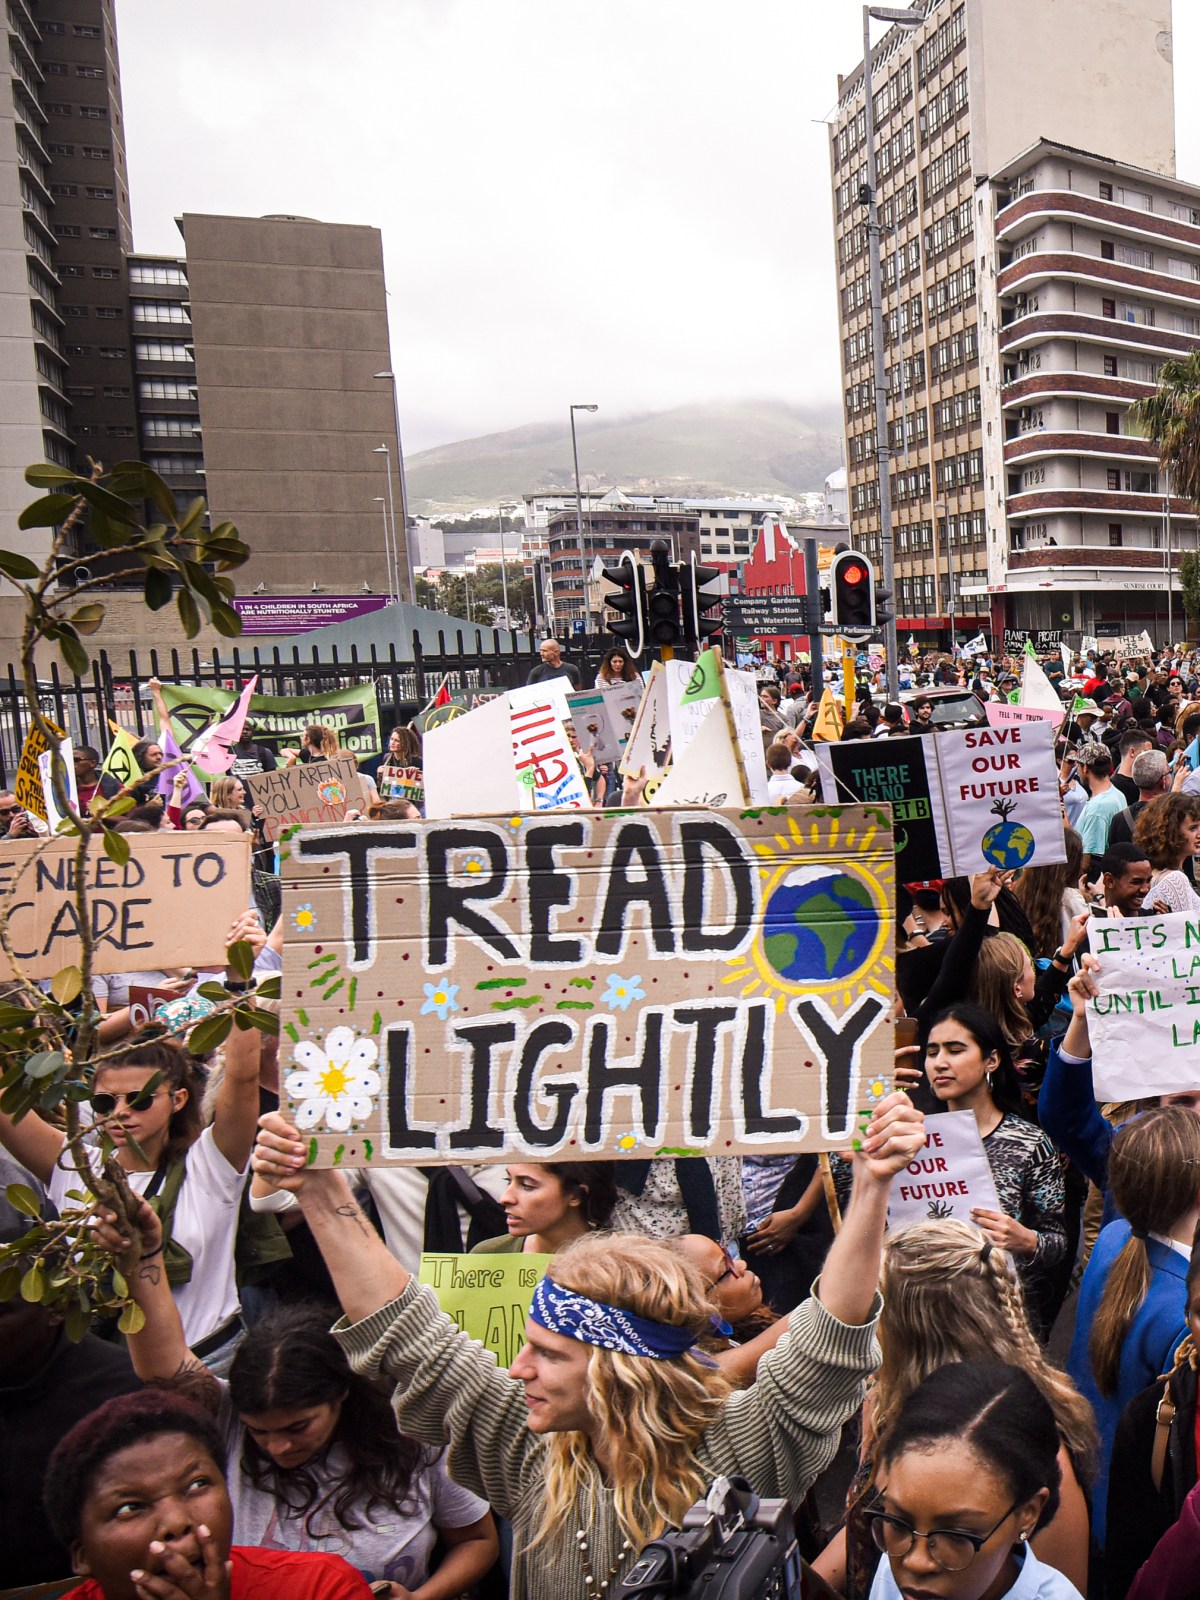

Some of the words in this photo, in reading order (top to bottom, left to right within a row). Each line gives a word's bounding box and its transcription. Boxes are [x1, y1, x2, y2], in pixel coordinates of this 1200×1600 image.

[575, 621, 582, 629] P
[843, 626, 874, 634] Parliament
[1004, 630, 1030, 641] PLANET
[1038, 630, 1061, 642] PROFIT
[1119, 635, 1144, 644] THIS
[846, 649, 852, 657] 2
[1119, 648, 1150, 658] SERIOUS
[245, 710, 348, 732] extinction
[998, 711, 1010, 719] TELL
[965, 728, 1022, 749] SAVE
[971, 753, 1021, 773] OUR
[250, 773, 291, 796] WHY
[388, 767, 422, 781] LOVE
[852, 764, 910, 788] THERE
[863, 786, 878, 801] IS
[881, 784, 905, 801] NO
[960, 777, 1040, 800] FUTURE
[258, 790, 300, 815] YOU
[917, 801, 928, 817] B
[0, 861, 16, 896] E
[36, 854, 146, 892] NEED
[161, 851, 227, 888] TO
[294, 813, 761, 971] TREAD
[2, 898, 153, 961] CARE
[1094, 988, 1173, 1016] UNTIL
[383, 992, 888, 1158] LIGHTLY
[906, 1157, 948, 1176] OUR
[900, 1179, 969, 1202] FUTURE
[423, 1256, 505, 1289] There
[518, 1268, 538, 1288] is
